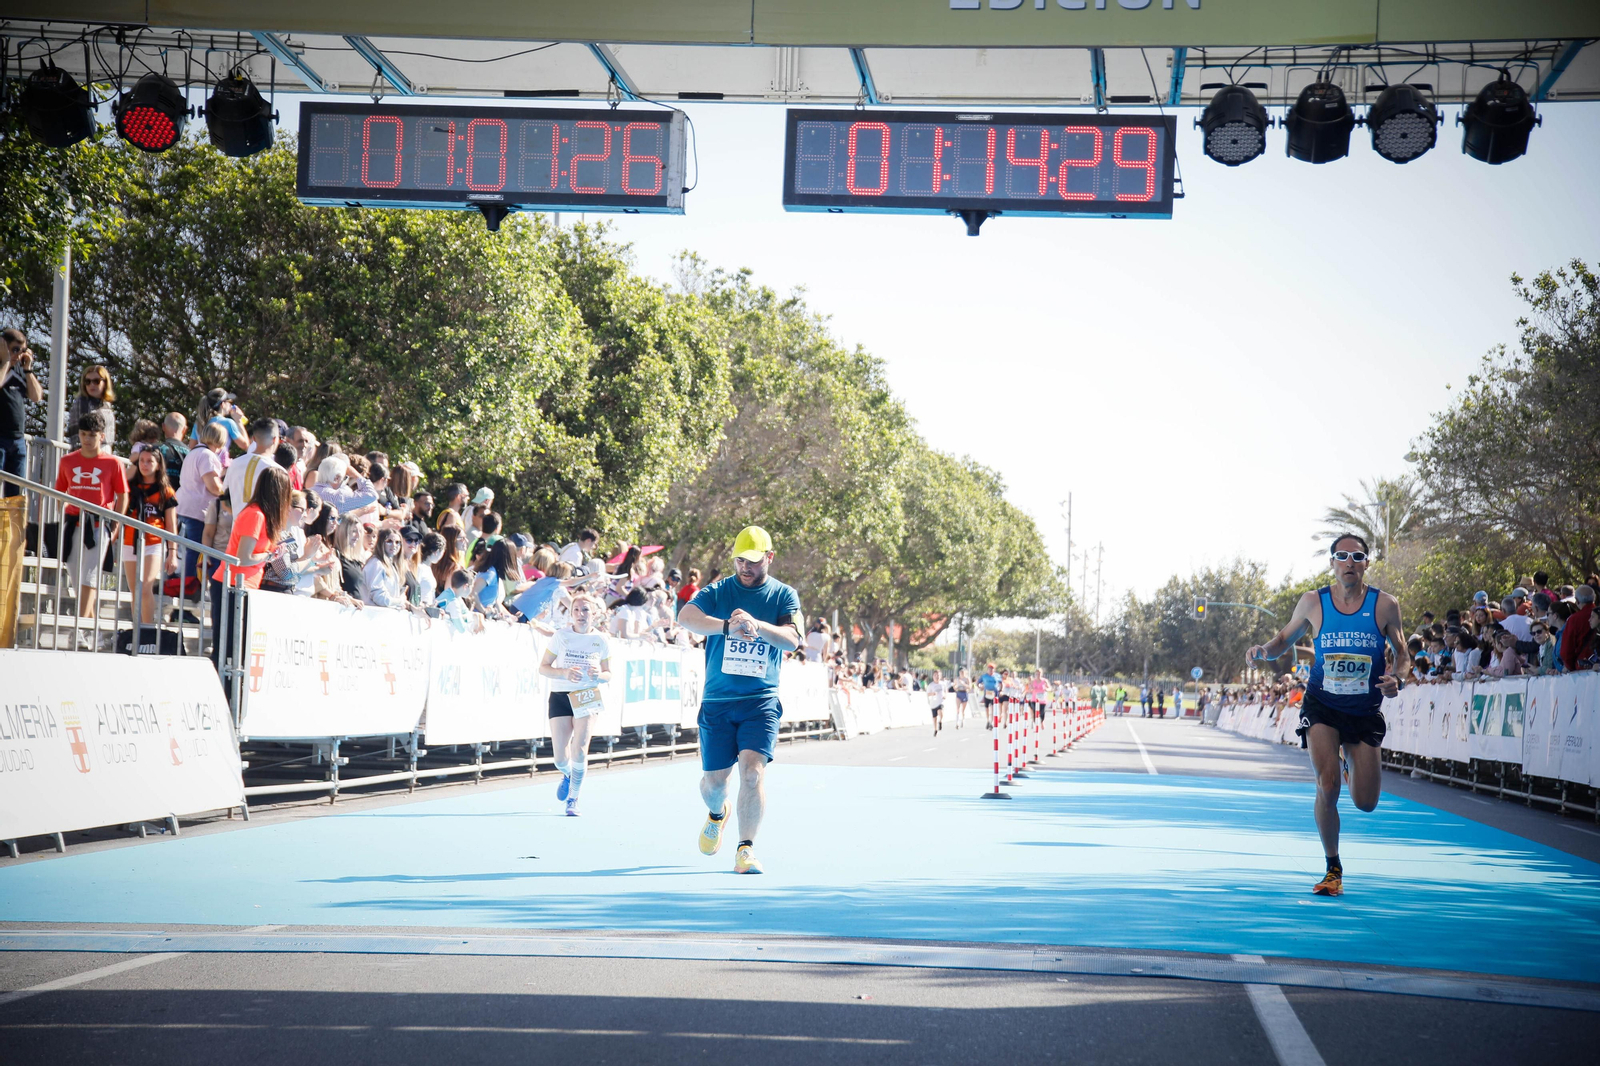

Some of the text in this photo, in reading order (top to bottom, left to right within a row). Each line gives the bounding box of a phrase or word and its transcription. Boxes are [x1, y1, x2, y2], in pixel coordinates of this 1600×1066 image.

[360, 115, 664, 196] 01:01:26
[846, 121, 1158, 202] 01:14:29
[1320, 631, 1377, 641] ATLETISMO
[729, 641, 766, 656] 5879
[1320, 638, 1378, 649] BENIDORM
[1329, 660, 1366, 673] 1504
[574, 689, 595, 702] 728
[0, 695, 59, 740] LMERÍA
